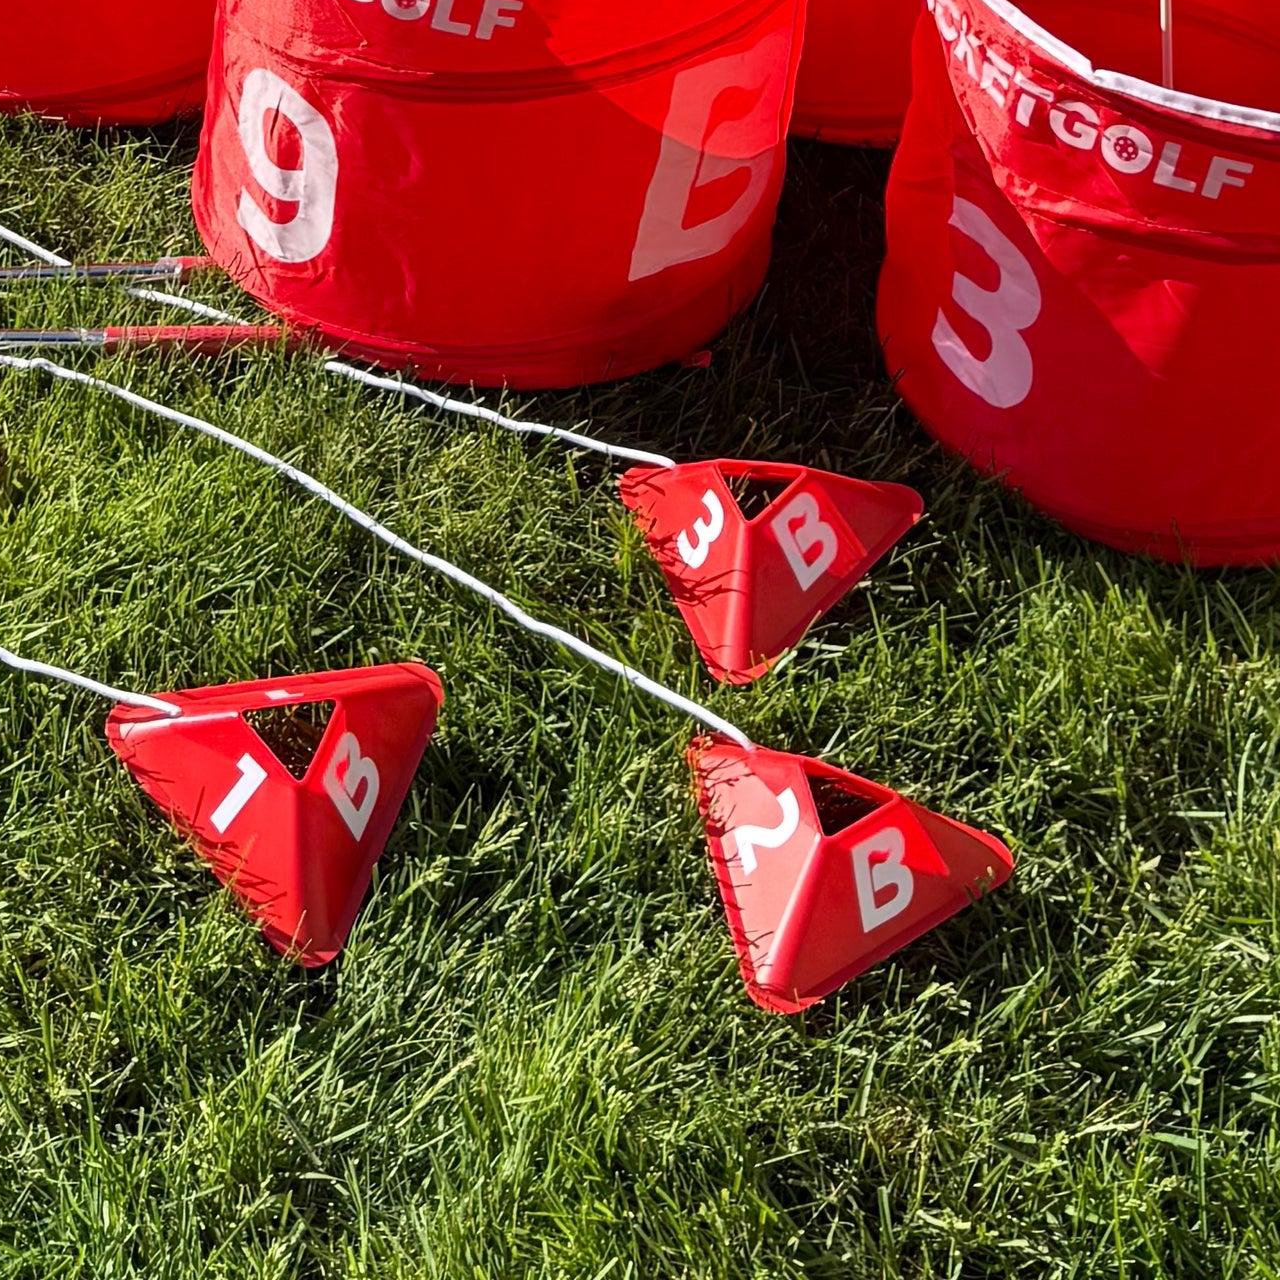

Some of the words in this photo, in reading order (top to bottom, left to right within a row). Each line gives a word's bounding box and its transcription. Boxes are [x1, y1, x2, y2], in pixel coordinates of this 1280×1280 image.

[237, 68, 338, 264] 9
[931, 195, 1042, 410] 3
[677, 488, 724, 570] 3
[771, 492, 838, 592] B
[209, 752, 268, 834] 1
[323, 731, 380, 842] B
[733, 787, 800, 876] 2
[851, 827, 914, 934] B
